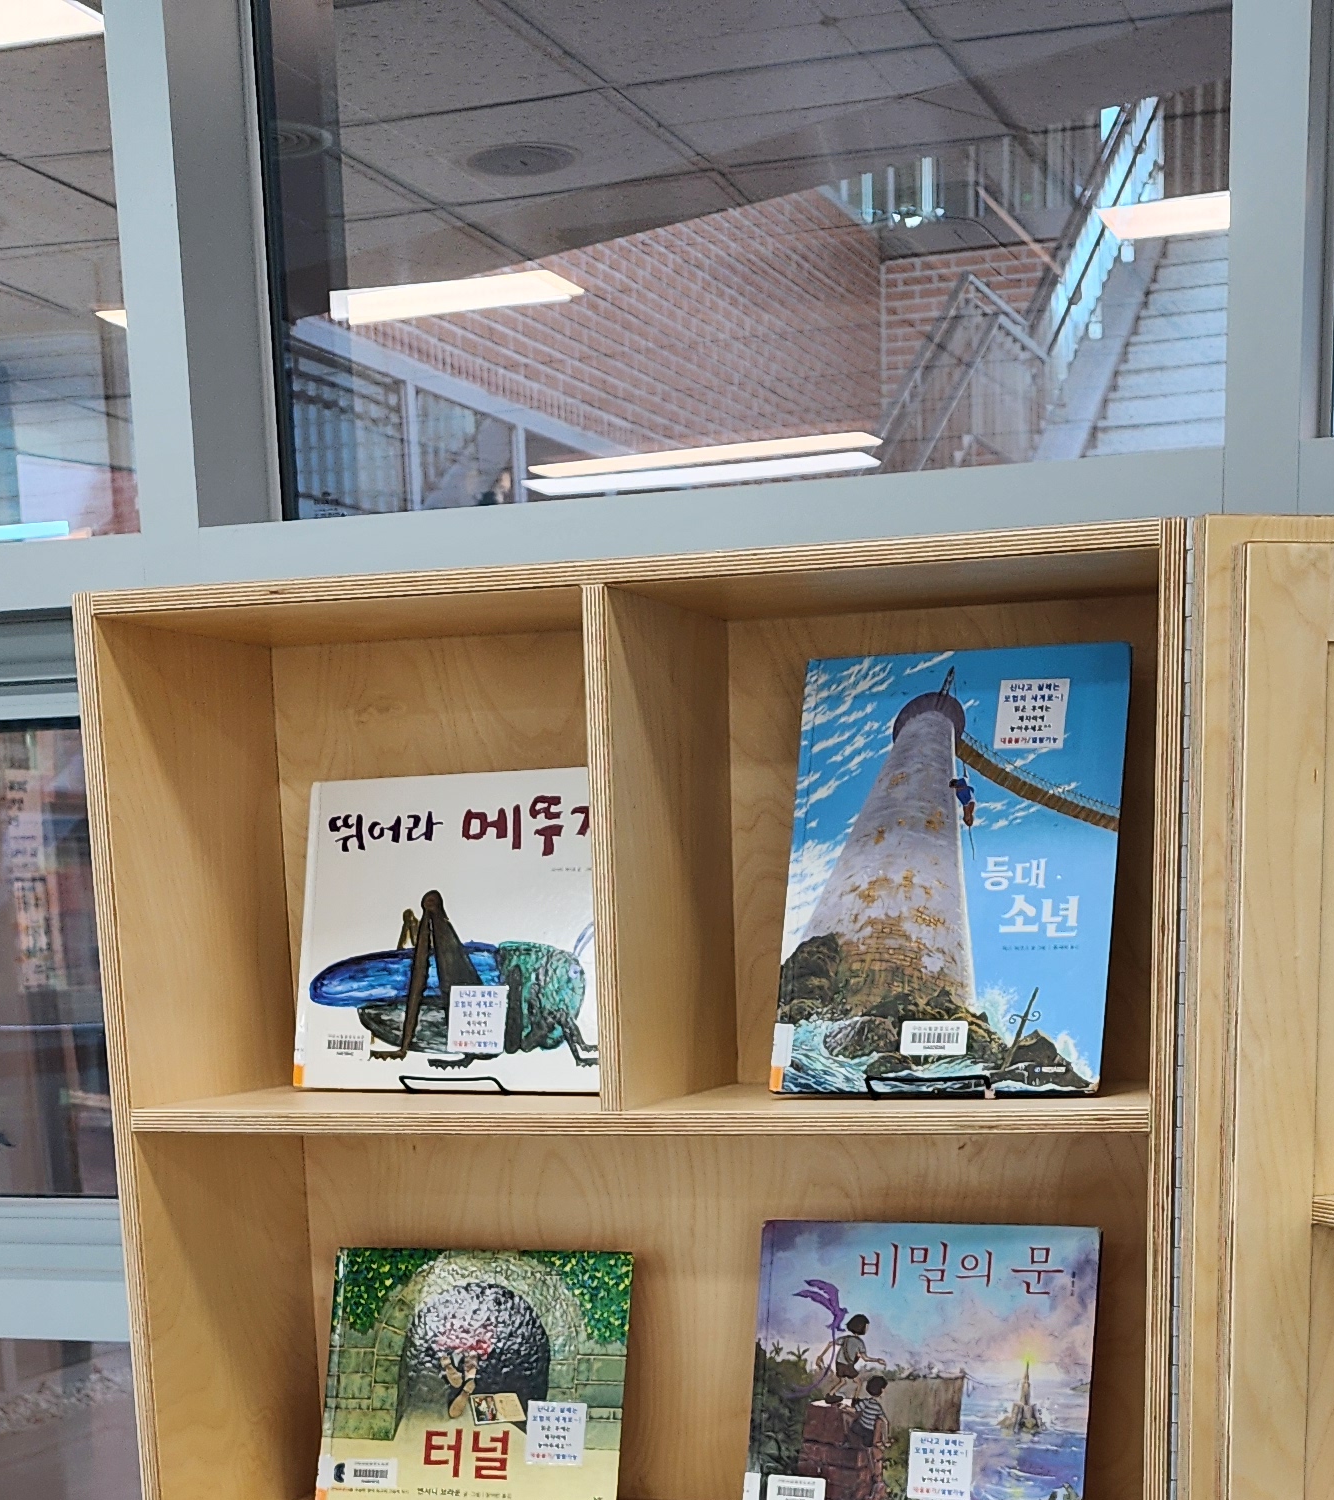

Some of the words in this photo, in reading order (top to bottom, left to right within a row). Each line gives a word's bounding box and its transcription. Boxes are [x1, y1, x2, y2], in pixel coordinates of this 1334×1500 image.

[328, 811, 443, 852] 뛰어라
[981, 856, 1047, 891] 등대
[999, 894, 1079, 937] 소년
[859, 1241, 993, 1295] 비밀의
[1011, 1247, 1064, 1295] 문
[423, 1428, 510, 1480] 터널
